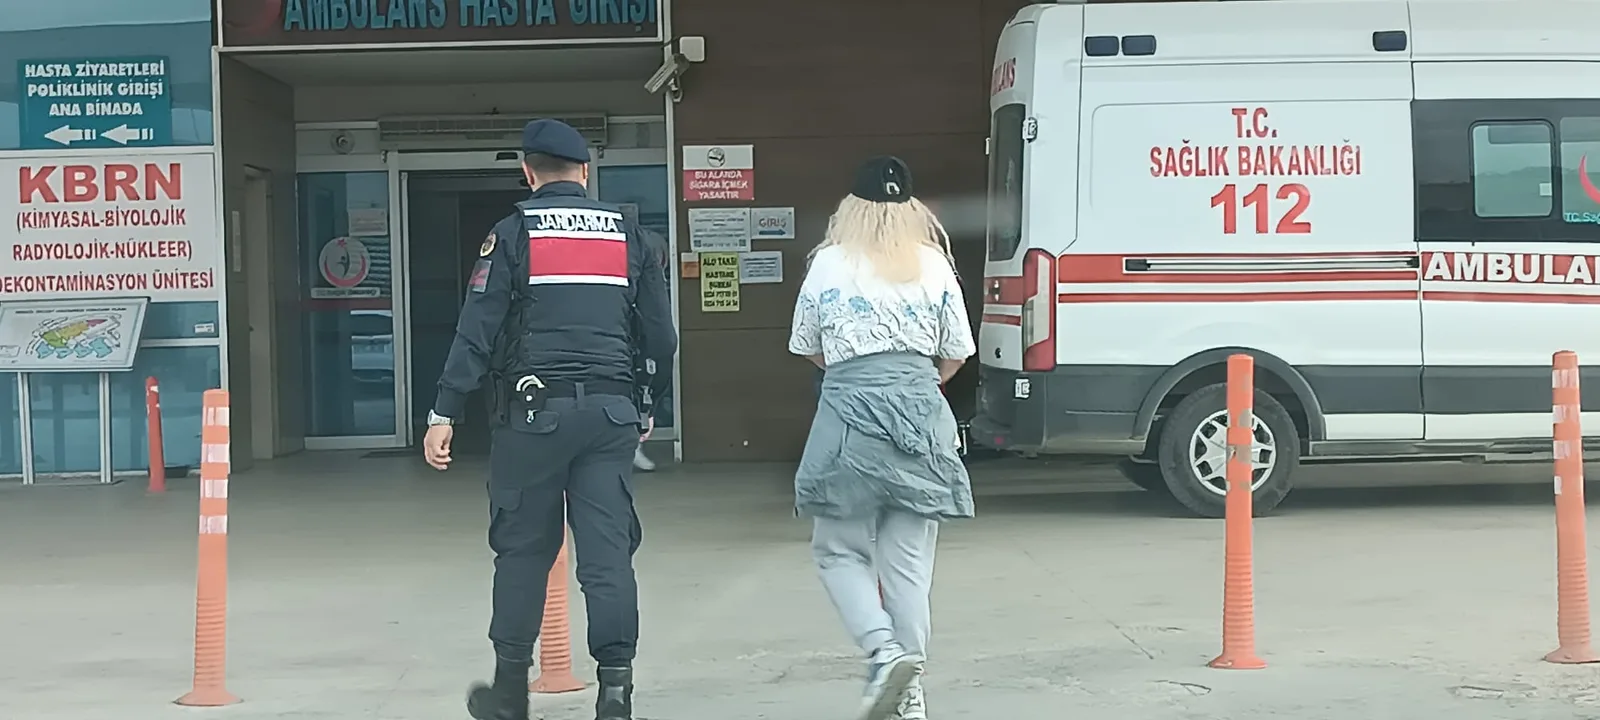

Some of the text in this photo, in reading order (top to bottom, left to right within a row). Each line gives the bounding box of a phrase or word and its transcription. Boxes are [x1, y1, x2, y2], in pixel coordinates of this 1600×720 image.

[284, 0, 447, 31] AMBULANS
[460, 0, 556, 27] HASTA
[25, 60, 165, 77] HASTA ZİYARETLERİ
[27, 79, 164, 99] POLİKLİNİK GİRİŞİ
[49, 99, 144, 117] ANA BİNADA
[1231, 107, 1278, 138] T.C.
[1149, 138, 1361, 177] SAĞLIK BAKANLIĞI
[19, 163, 182, 204] KBRN
[16, 205, 186, 233] (KİMYASAL-BİYOLOJİK
[536, 213, 619, 232] JANDARMA
[1210, 183, 1312, 235] 112
[13, 238, 192, 262] RADYOLOJİK-NÜKLEER)
[0, 267, 214, 293] EKONTAMİNASYON ÜNİTESİ
[1423, 251, 1600, 284] AMBULA
